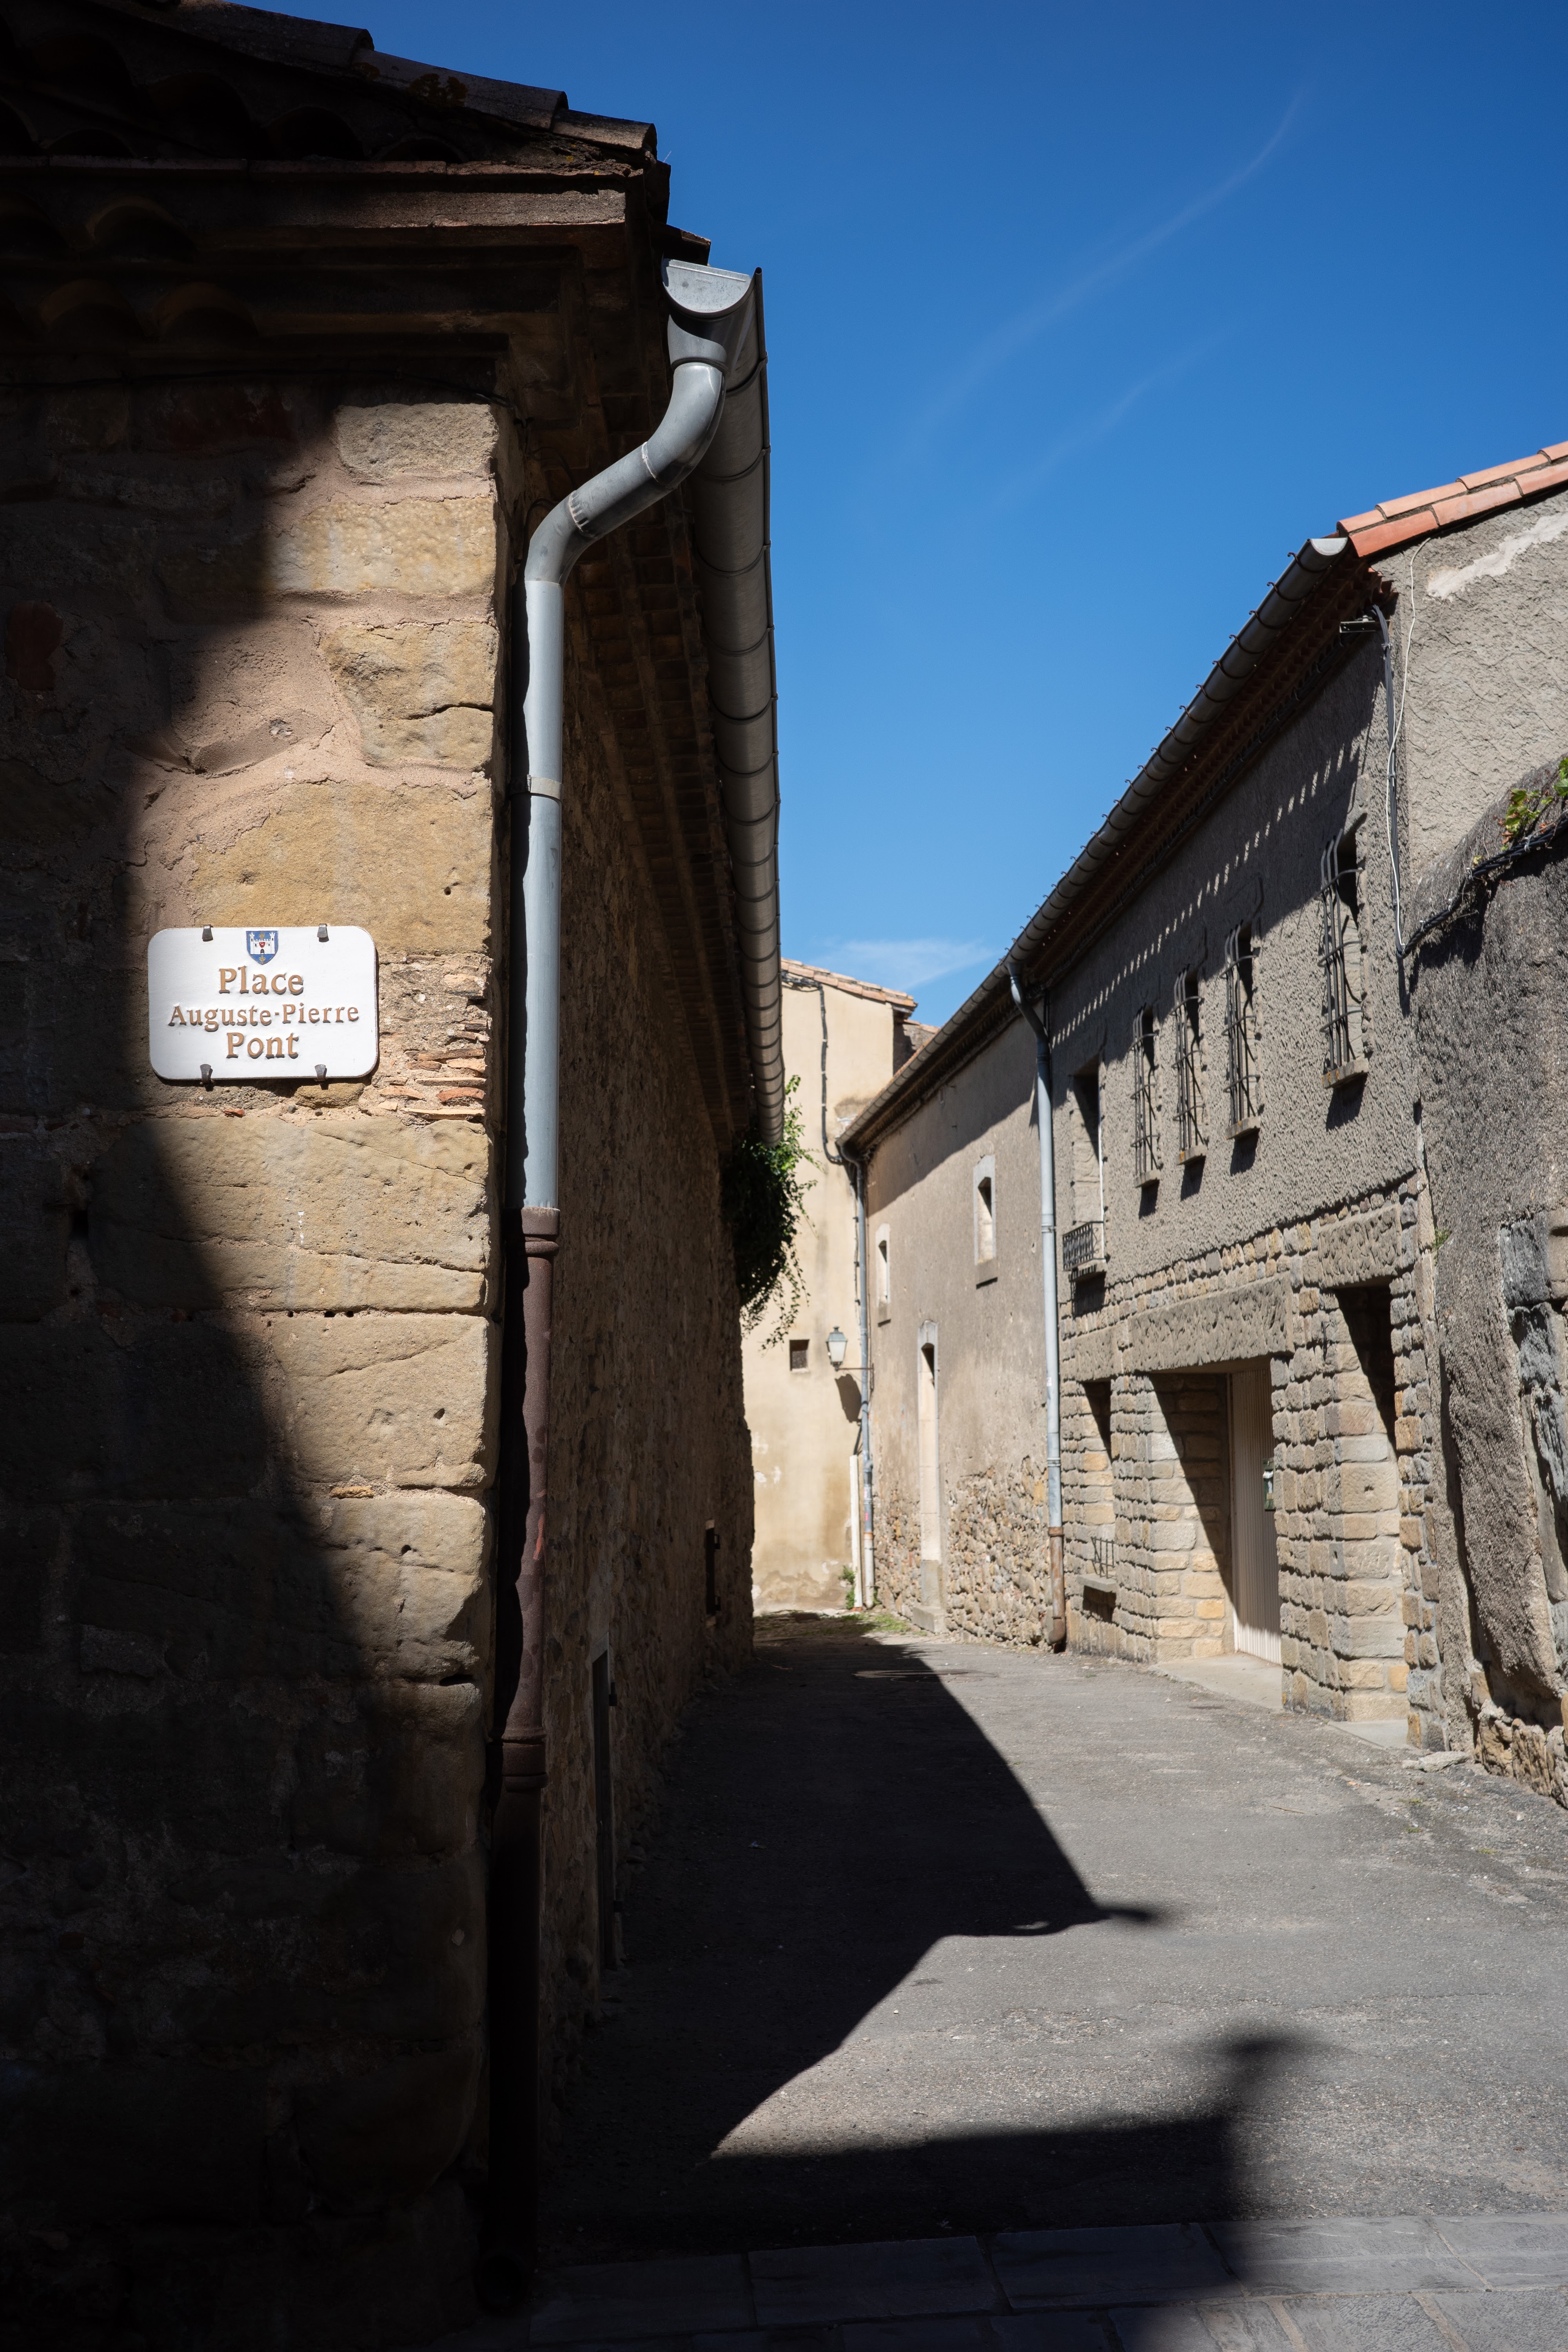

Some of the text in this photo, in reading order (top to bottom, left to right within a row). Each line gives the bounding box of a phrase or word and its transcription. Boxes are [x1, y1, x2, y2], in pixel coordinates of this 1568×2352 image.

[219, 965, 303, 995] Place
[168, 1002, 359, 1032] Auguste-Pierre
[226, 1032, 299, 1058] Pont
